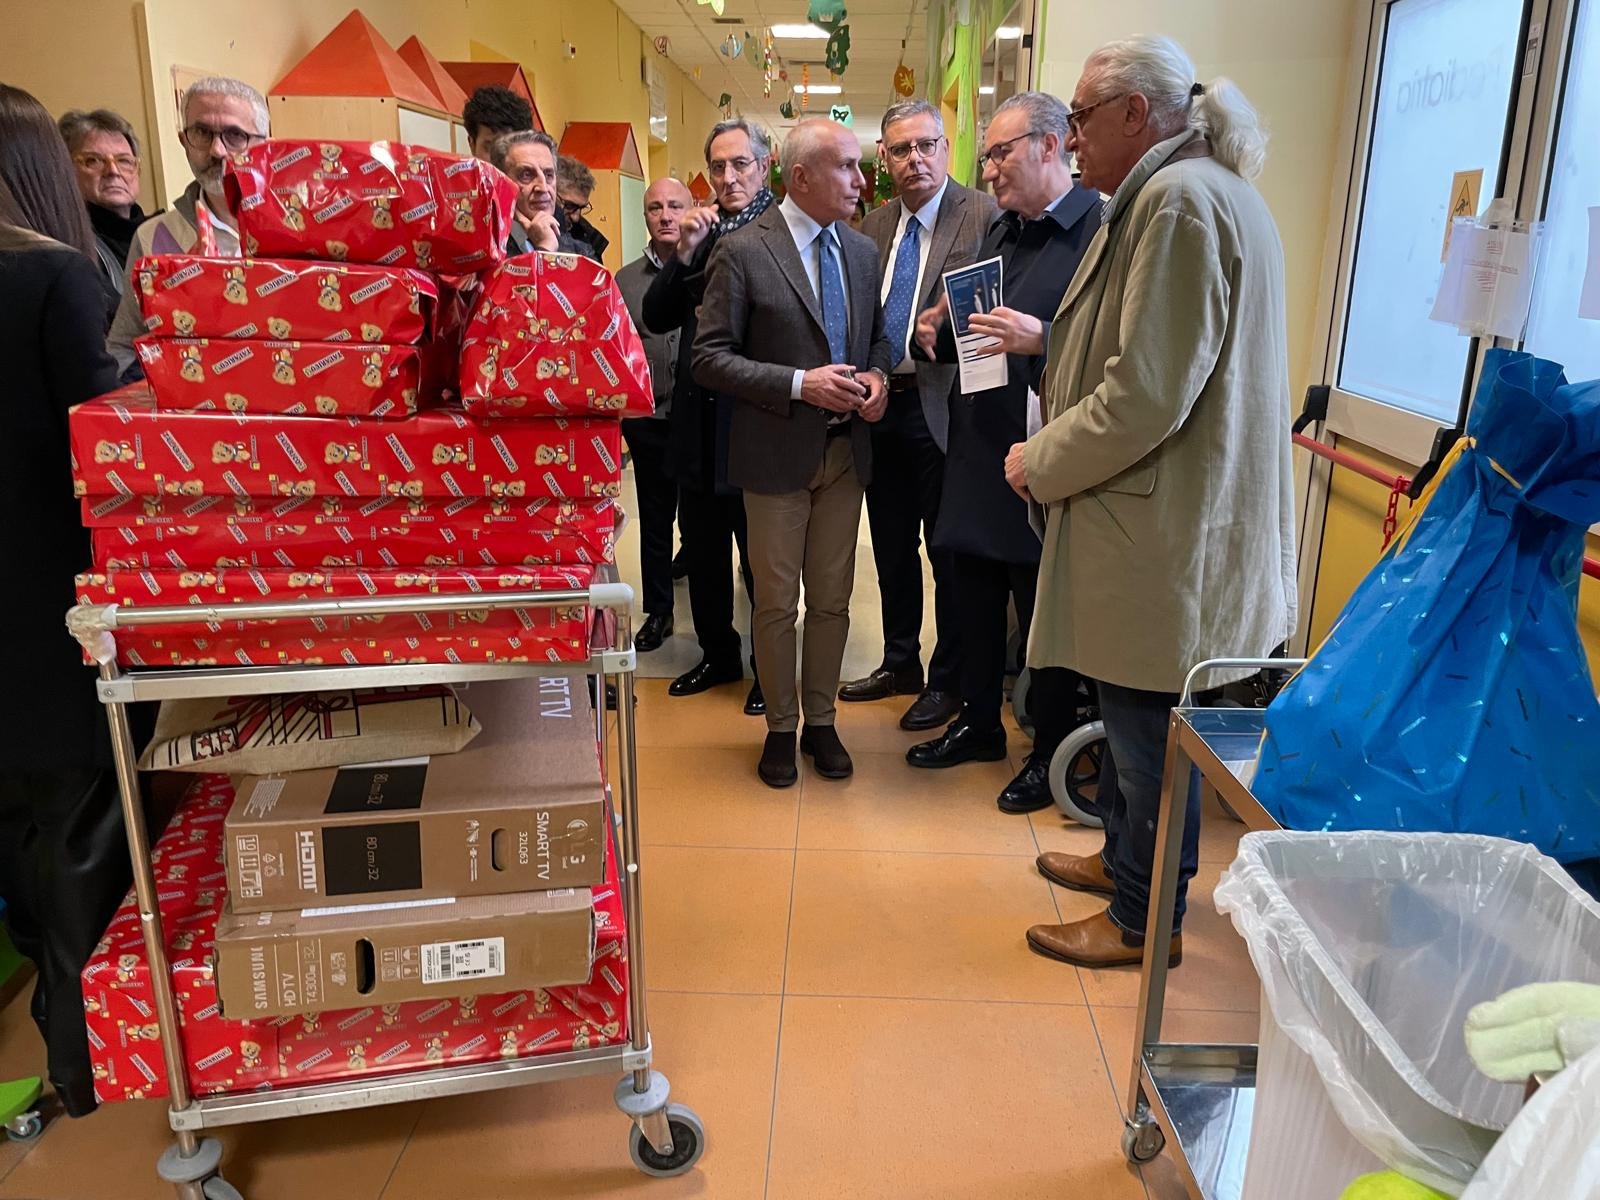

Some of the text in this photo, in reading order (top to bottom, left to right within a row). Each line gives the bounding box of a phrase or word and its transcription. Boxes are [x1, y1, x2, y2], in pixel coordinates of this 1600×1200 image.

[300, 830, 317, 890] HDMI
[518, 831, 529, 865] 32LQ63
[536, 811, 550, 880] SMART TV
